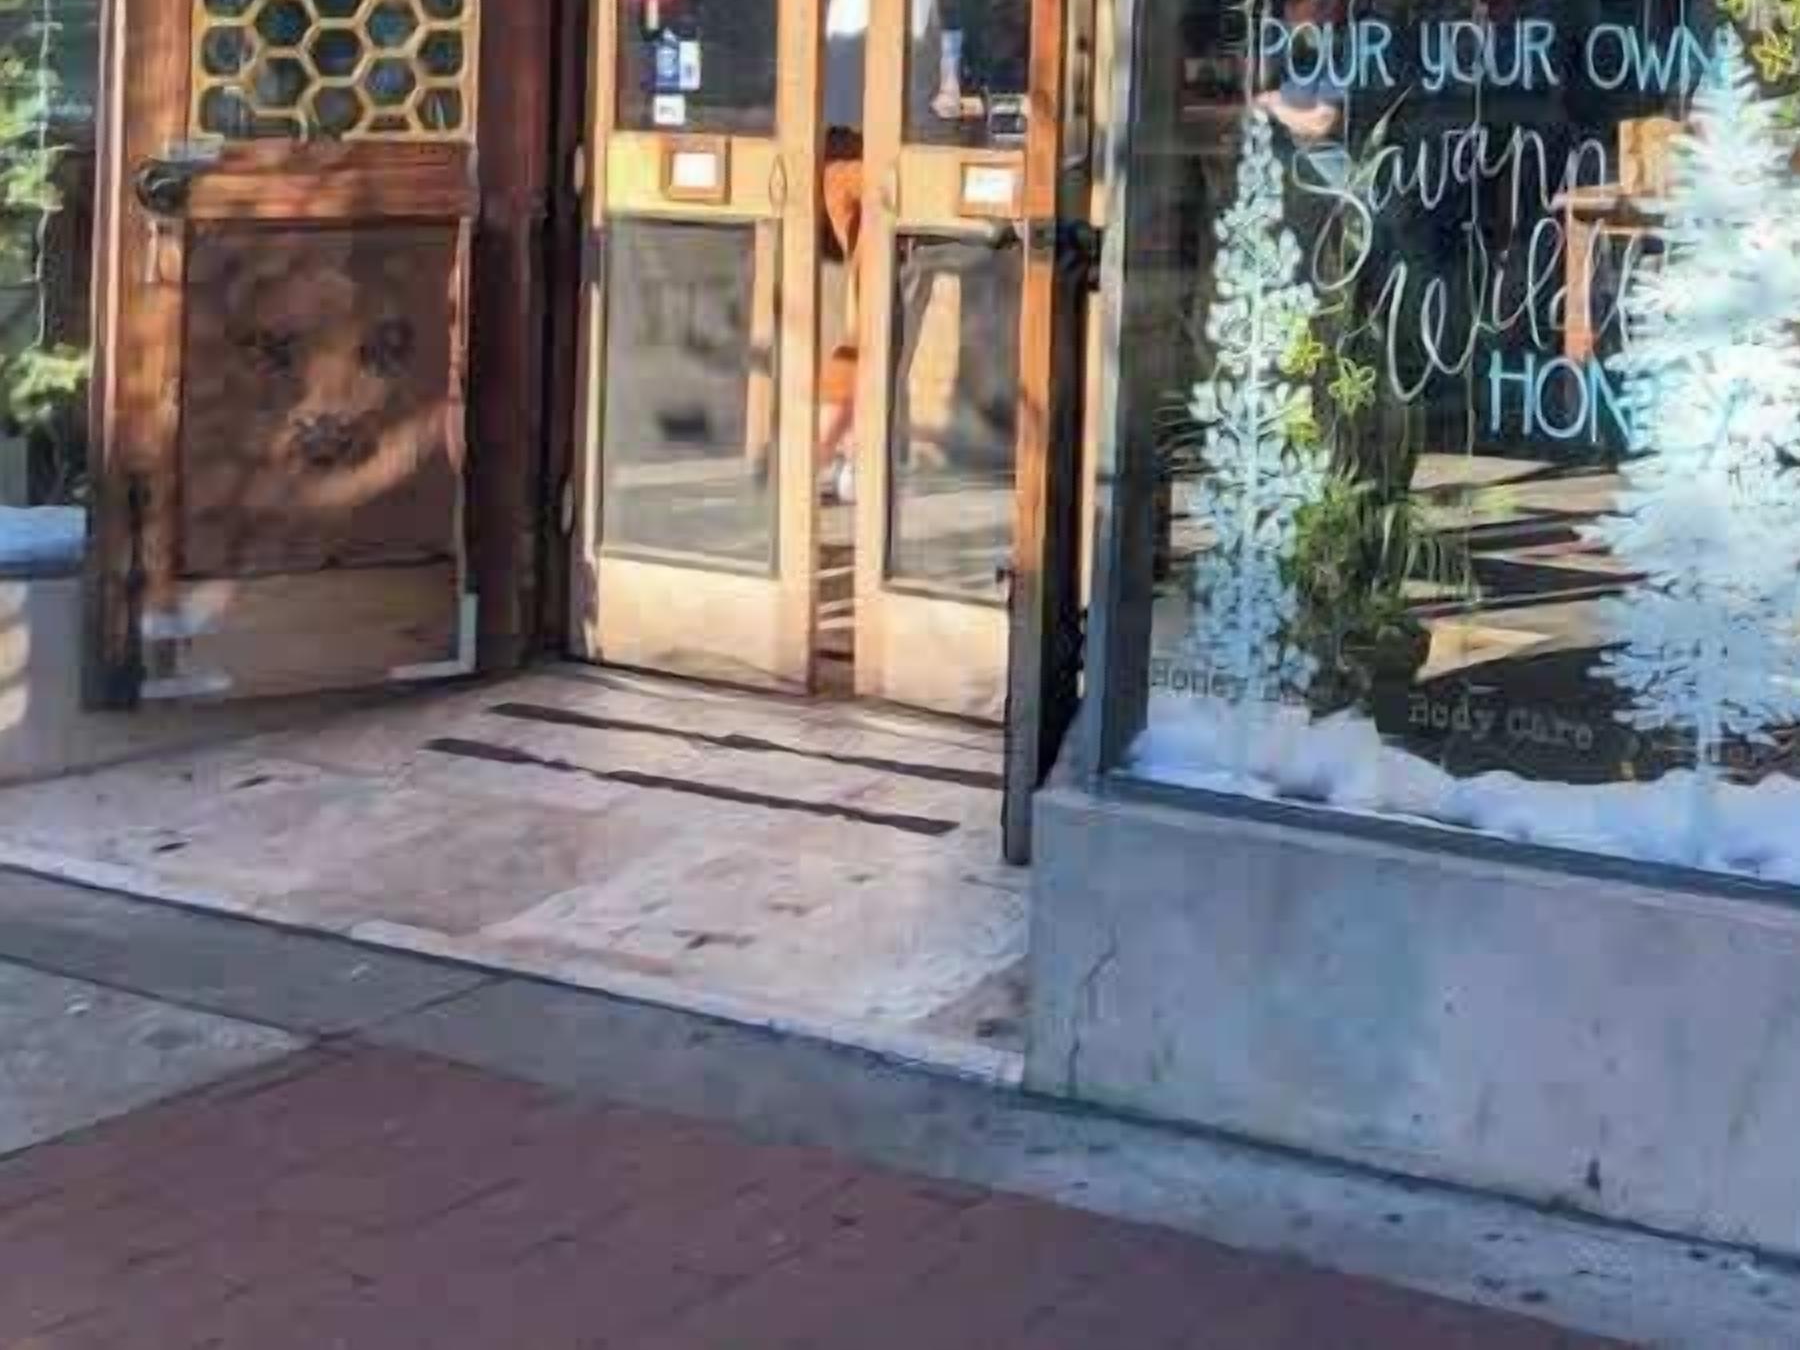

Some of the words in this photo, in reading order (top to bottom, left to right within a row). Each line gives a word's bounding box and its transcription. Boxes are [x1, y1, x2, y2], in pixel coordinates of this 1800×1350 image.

[1258, 18, 1396, 88] POUR
[1420, 19, 1560, 93] YOUR
[1585, 22, 1732, 93] OWN
